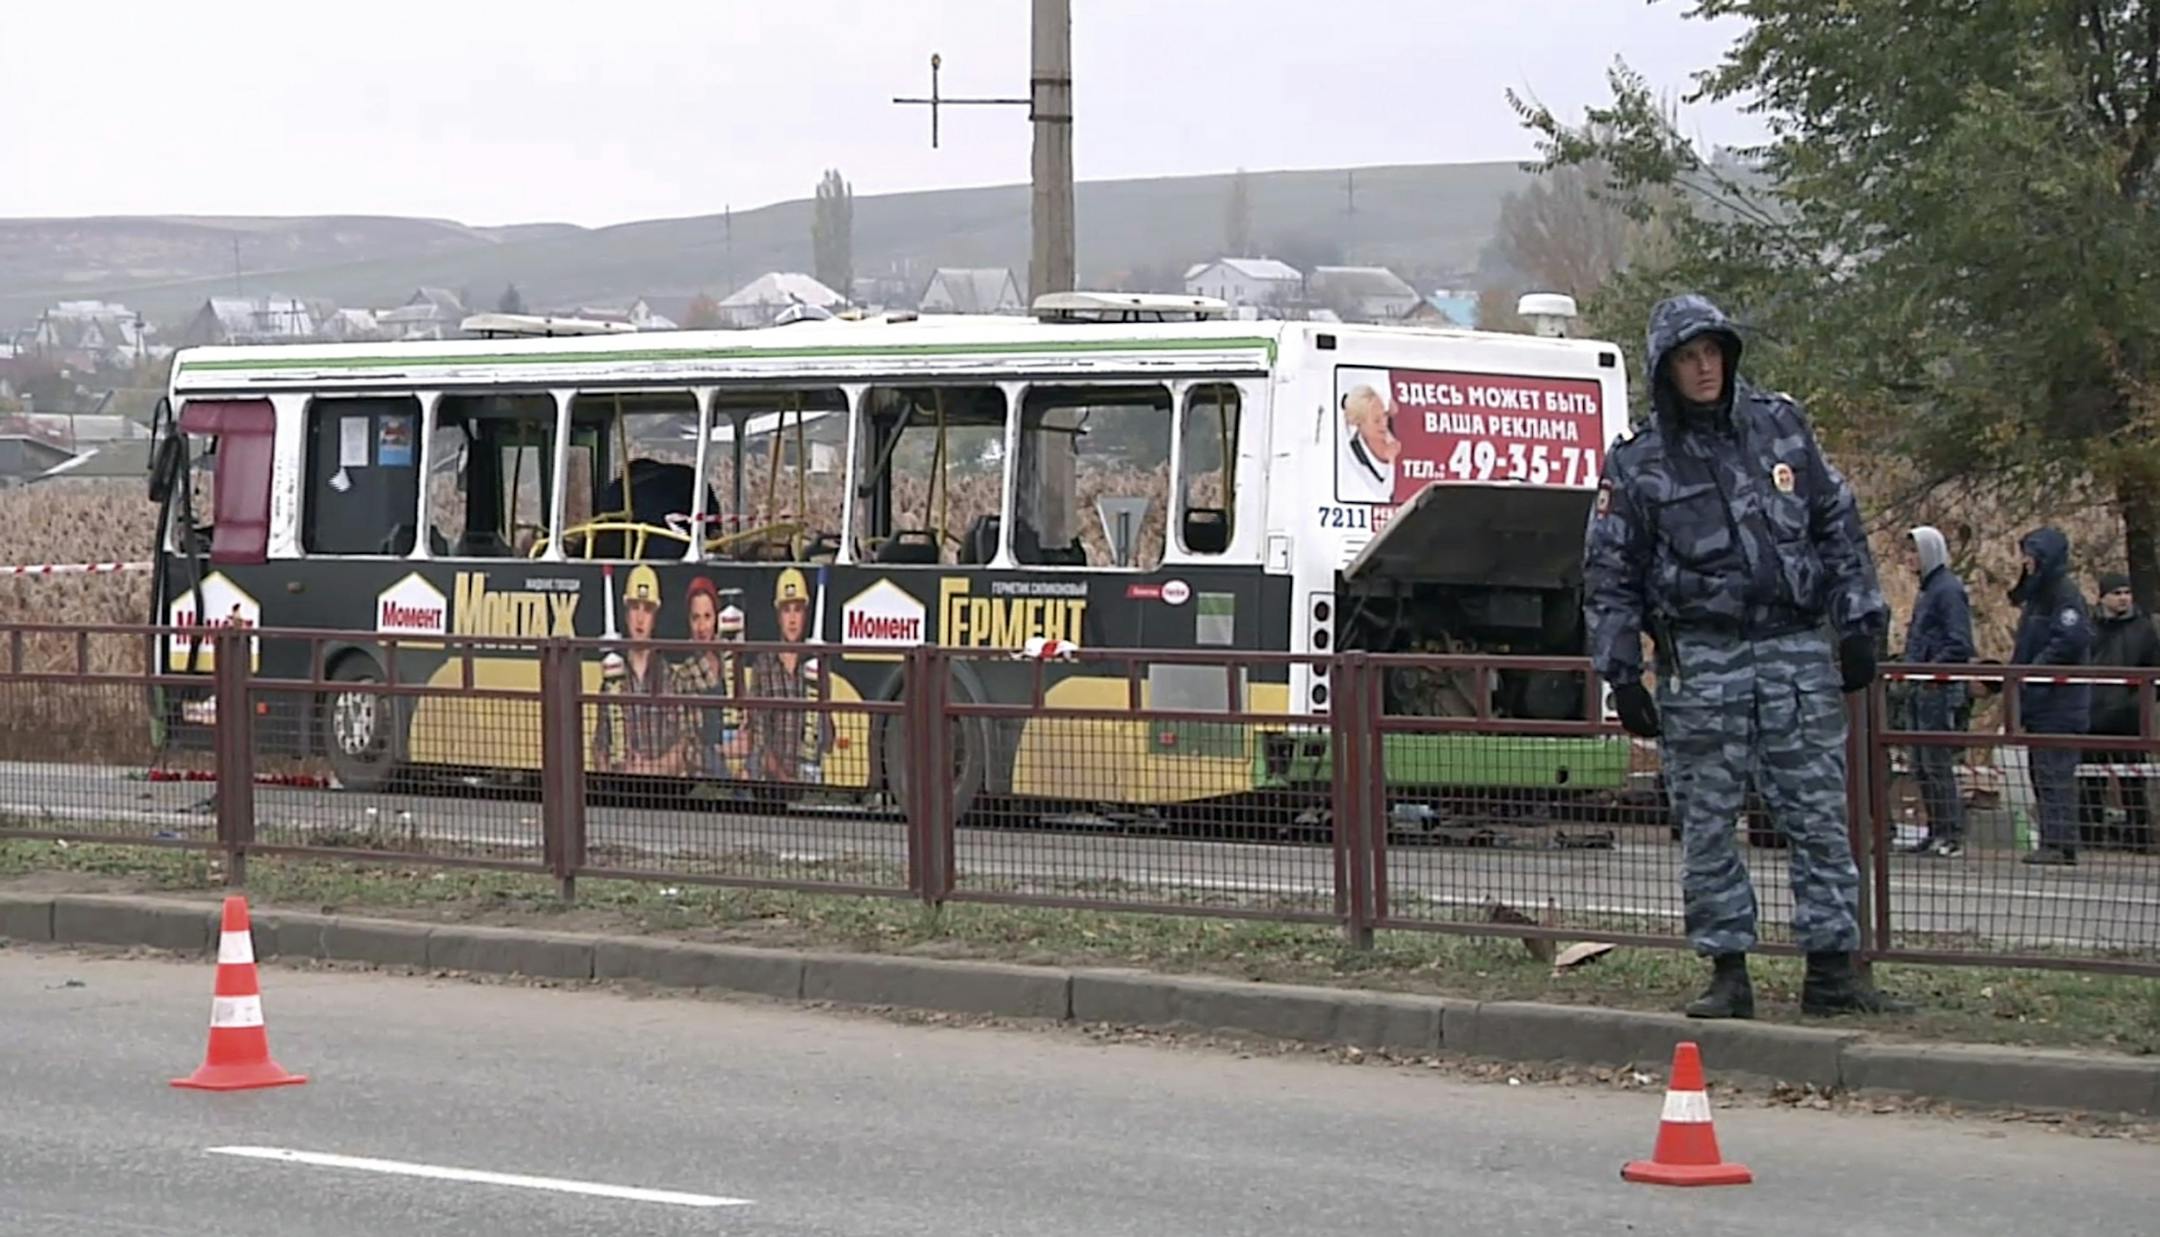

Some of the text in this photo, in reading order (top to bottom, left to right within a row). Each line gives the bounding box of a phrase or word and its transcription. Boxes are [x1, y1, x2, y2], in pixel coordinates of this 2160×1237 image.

[1396, 382, 1597, 414] ЗДЕСЬ МОЖЕТ БЫТЬ
[1424, 412, 1579, 441] ВАША РЕКЛАМА
[1449, 440, 1600, 488] 49-35-71
[1318, 505, 1368, 529] 7211
[383, 601, 442, 629] Момент
[848, 610, 920, 640] Момент
